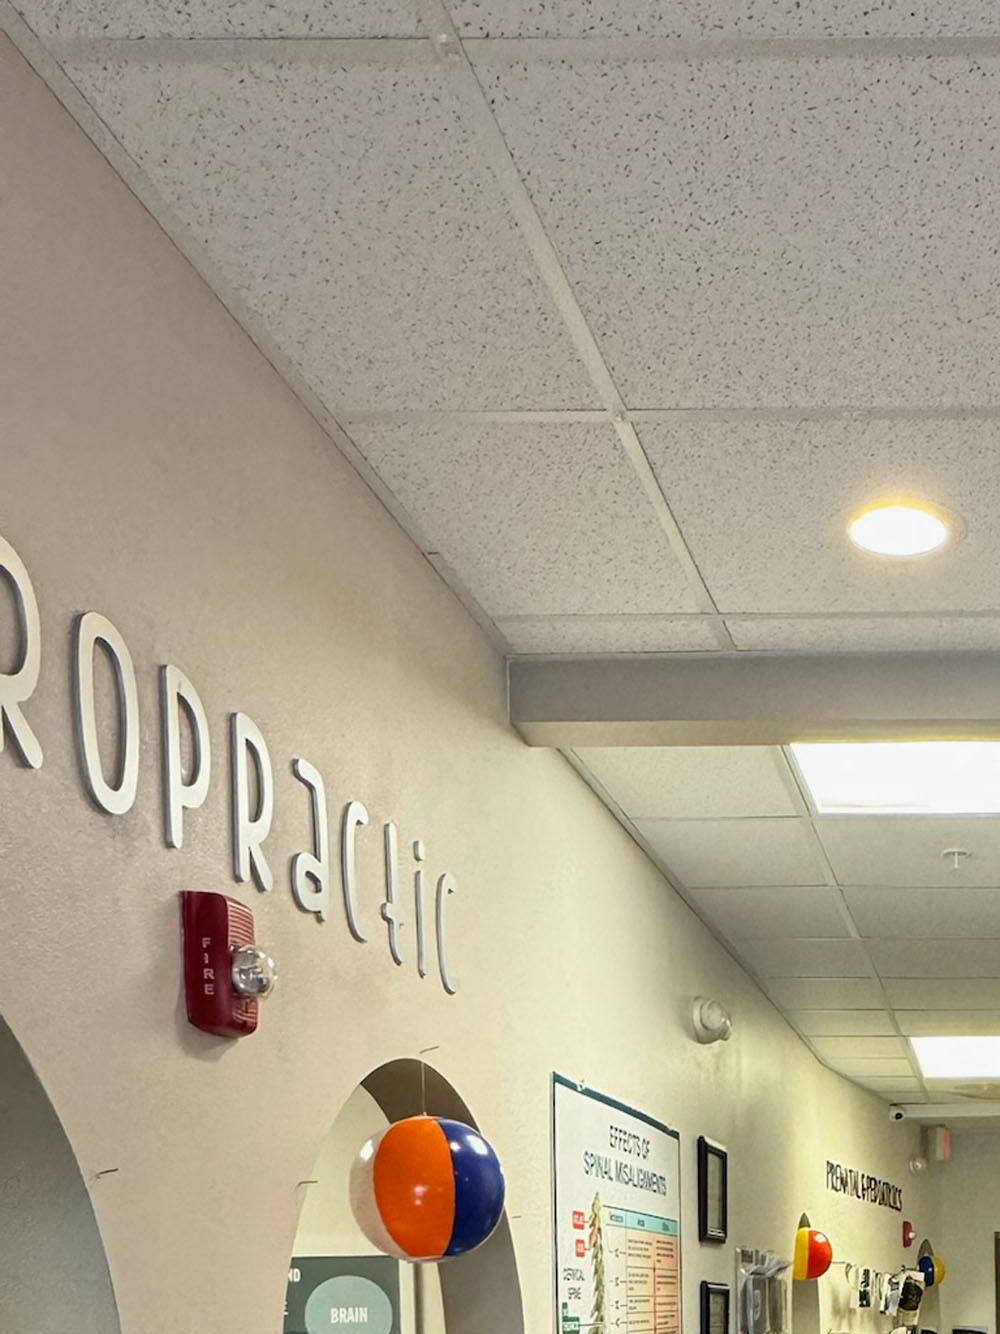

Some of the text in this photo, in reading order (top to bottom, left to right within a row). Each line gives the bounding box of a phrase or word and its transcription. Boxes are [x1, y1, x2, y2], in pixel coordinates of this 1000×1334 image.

[201, 937, 216, 996] FIRE
[583, 1150, 614, 1181] SPINAL
[330, 1306, 369, 1324] BRAIN
